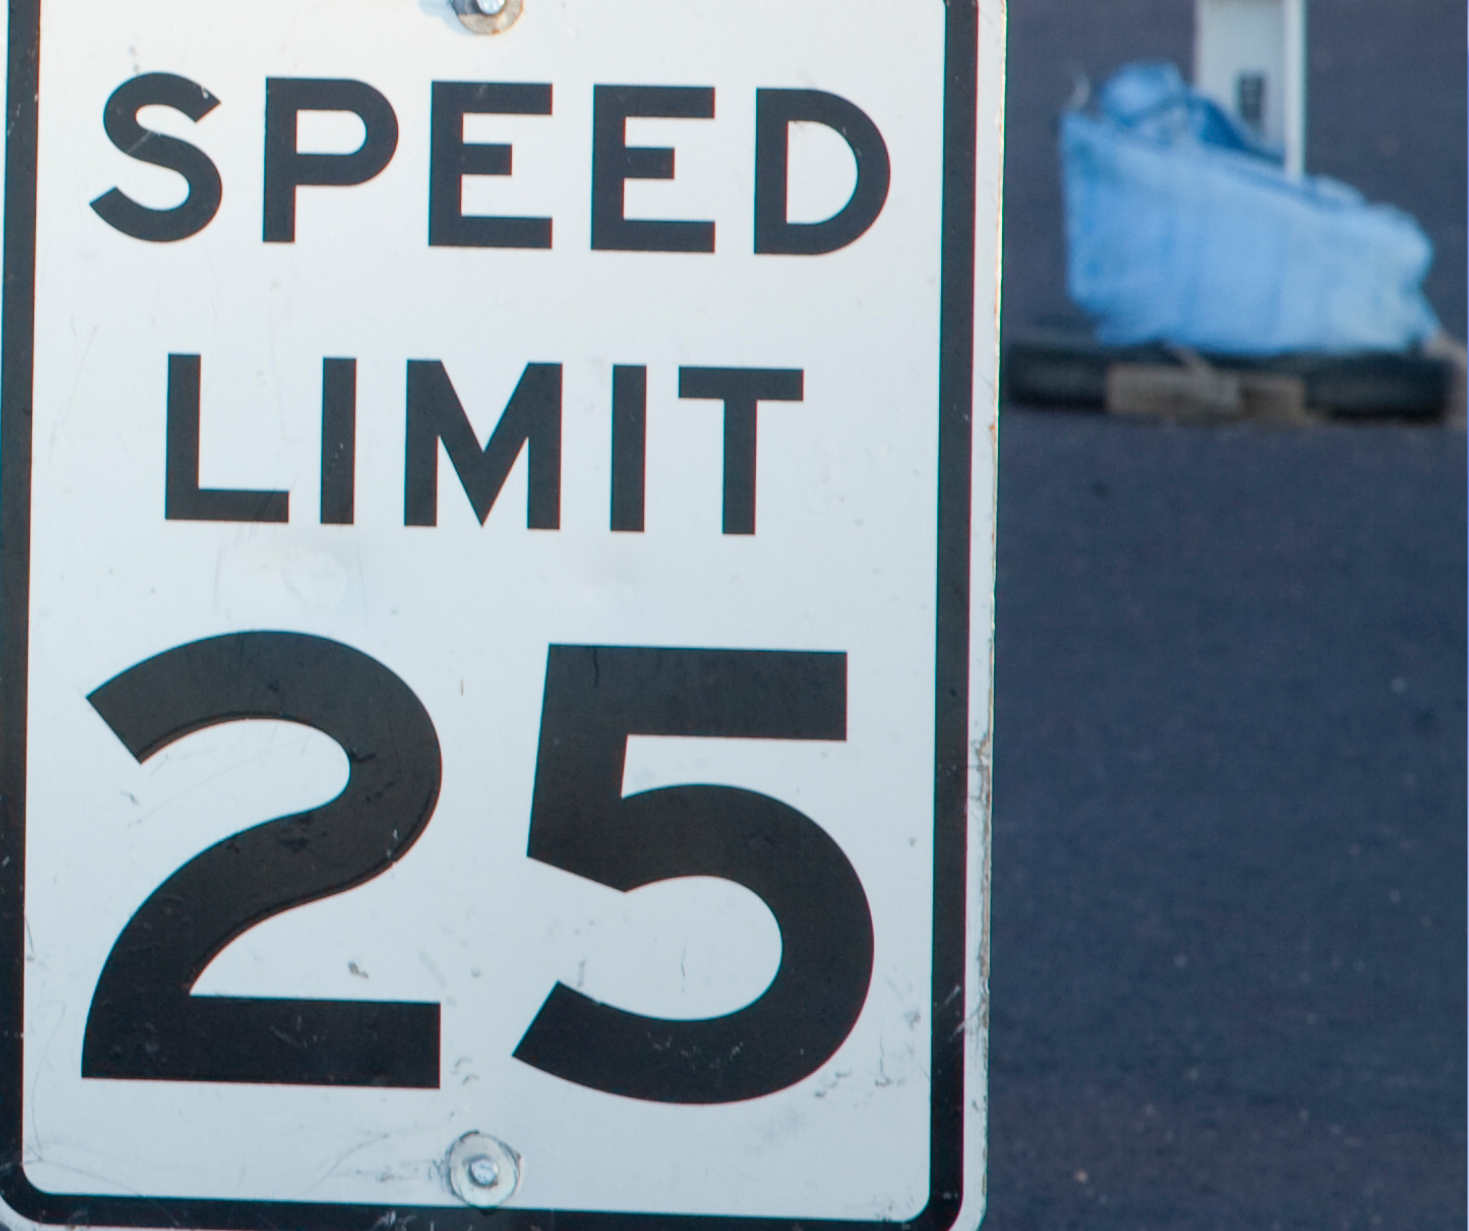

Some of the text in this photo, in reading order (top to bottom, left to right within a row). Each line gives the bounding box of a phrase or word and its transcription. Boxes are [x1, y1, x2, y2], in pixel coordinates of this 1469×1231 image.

[88, 71, 891, 256] SPEED
[164, 352, 804, 535] LIMIT
[80, 629, 875, 1106] 25
